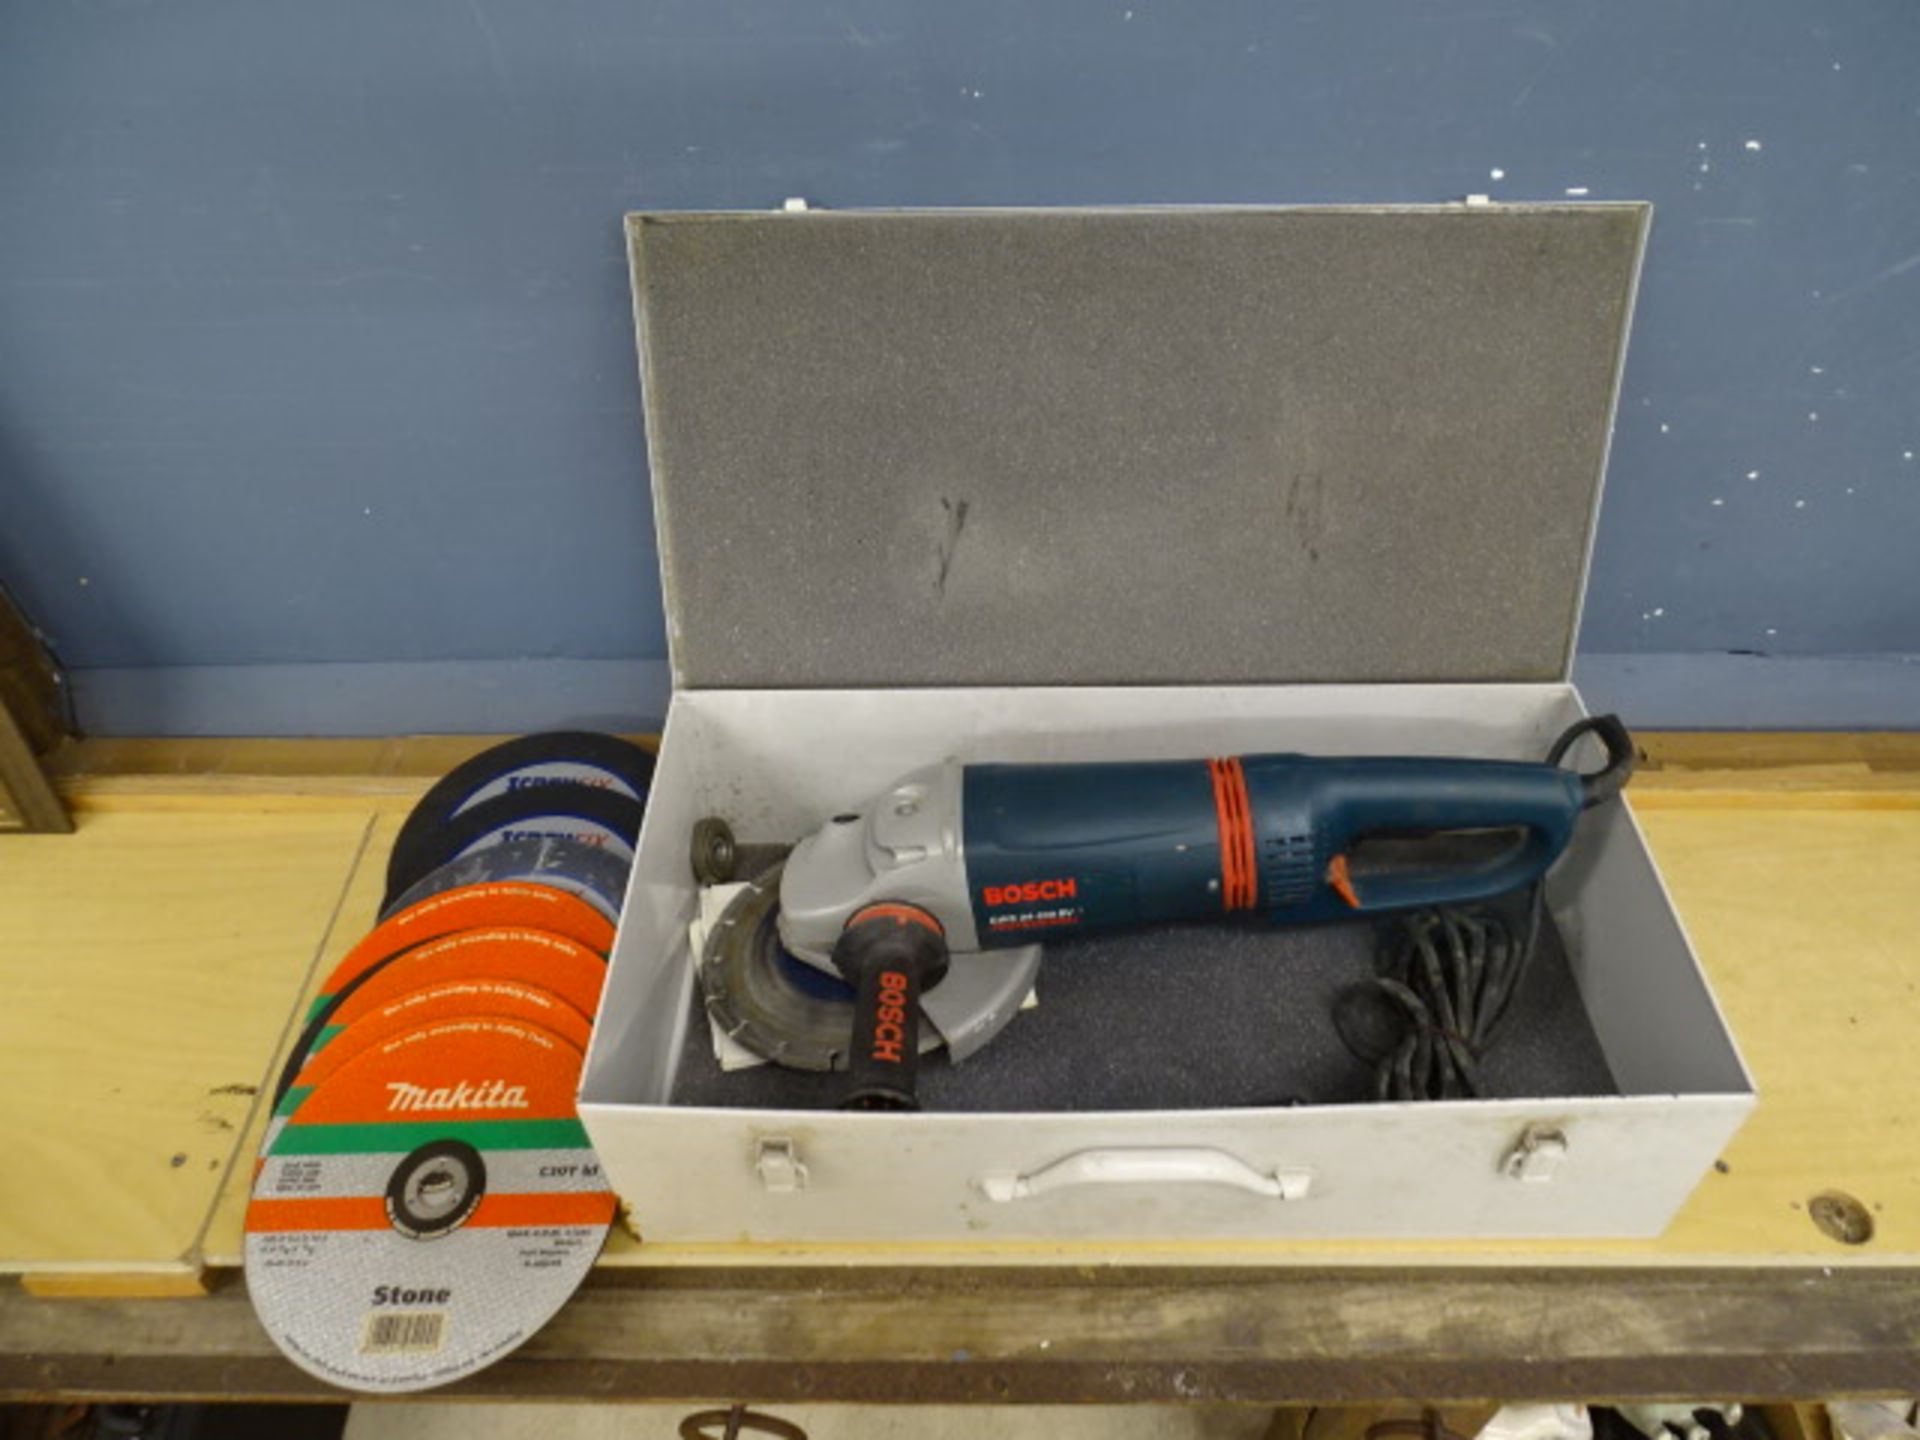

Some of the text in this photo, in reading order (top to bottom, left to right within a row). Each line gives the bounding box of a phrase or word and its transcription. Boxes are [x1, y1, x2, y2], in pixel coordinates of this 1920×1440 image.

[984, 879, 1077, 905] BOSCH
[873, 972, 906, 1062] BOSCH
[386, 1079, 529, 1112] Makita
[372, 1285, 452, 1306] Stone
